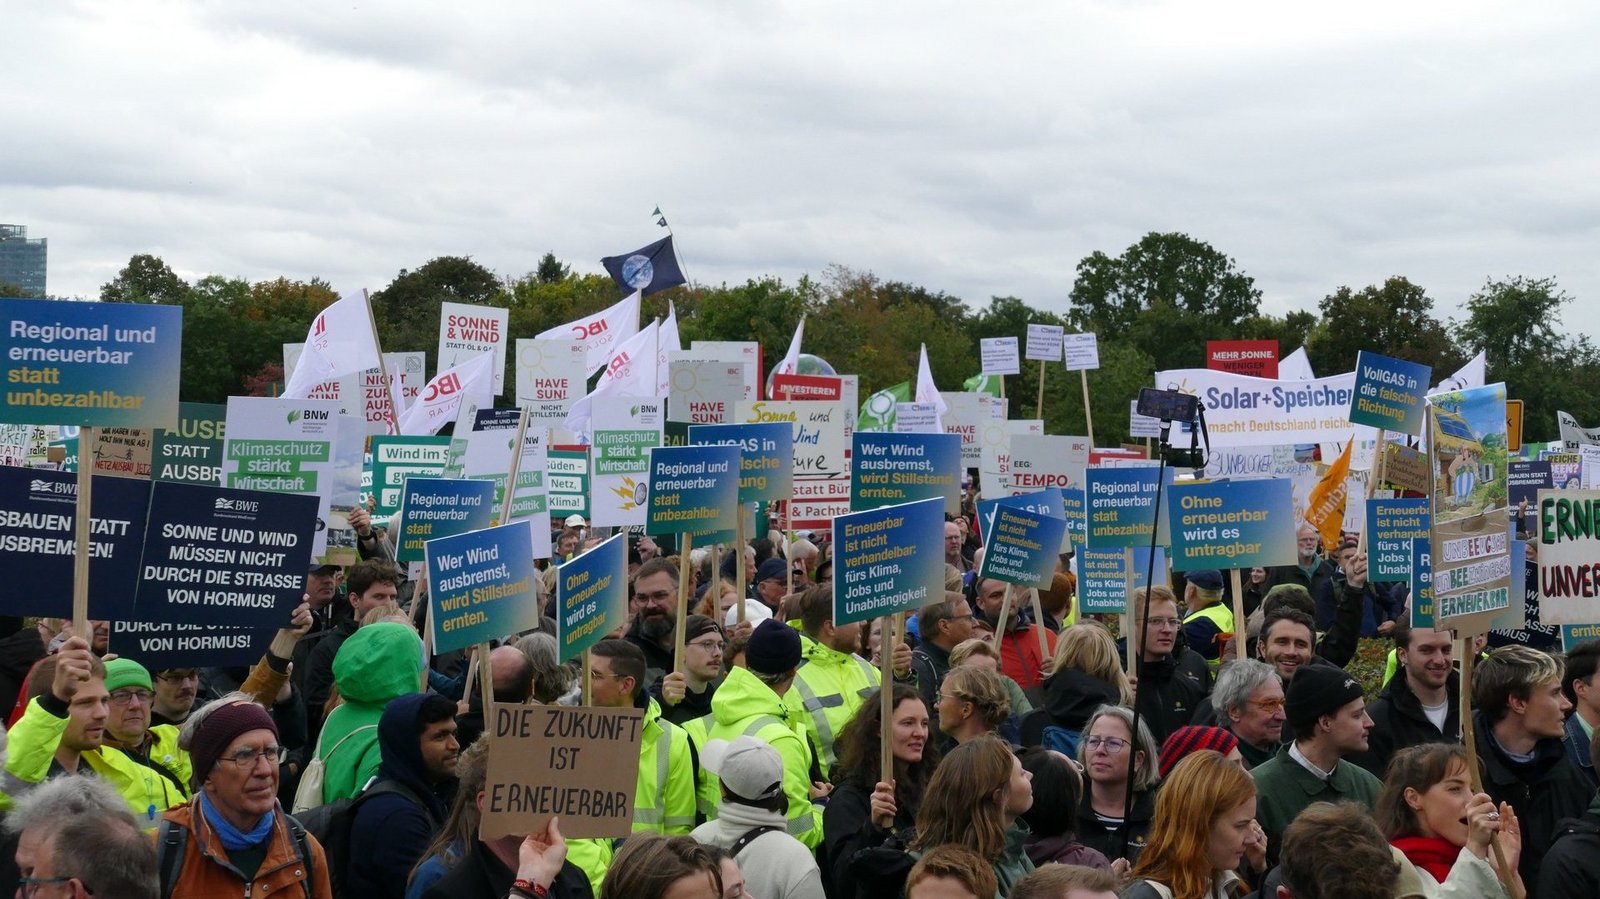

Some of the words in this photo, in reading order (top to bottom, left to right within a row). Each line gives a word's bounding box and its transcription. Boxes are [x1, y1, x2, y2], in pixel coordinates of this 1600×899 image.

[448, 315, 499, 331] SONNE
[10, 320, 108, 344] Regional
[115, 326, 156, 343] und
[447, 328, 456, 339] &
[461, 329, 500, 343] WIND
[446, 342, 466, 350] STATT
[9, 345, 133, 365] erneuerbar
[8, 367, 59, 384] statt
[1363, 366, 1405, 385] VollGAS
[1407, 374, 1417, 389] in
[535, 379, 568, 388] HAVE
[780, 385, 836, 396] INVESTIEREN
[6, 390, 145, 410] unbezahlbar
[537, 390, 567, 400] SUN!
[1360, 383, 1377, 397] die
[1379, 387, 1417, 406] falsche
[303, 409, 329, 420] BNW
[641, 405, 657, 413] BNW
[690, 403, 724, 411] HAVE
[1357, 400, 1405, 421] Richtung
[692, 414, 724, 423] SUN!
[810, 408, 832, 422] und
[947, 425, 975, 433] HAVE
[1208, 419, 1246, 433] macht
[1249, 418, 1316, 431] Deutschland
[596, 433, 655, 444] Klimaschutz
[763, 438, 776, 451] in
[162, 444, 210, 459] STATT
[232, 442, 323, 457] Klimaschutz
[386, 448, 419, 459] Wind
[423, 448, 440, 459] im
[607, 445, 636, 457] stärkt
[861, 444, 888, 456] Wer
[891, 443, 924, 456] Wind
[247, 458, 292, 473] stärkt
[600, 459, 646, 471] Wirtschaft
[657, 462, 705, 476] Regional
[708, 461, 728, 472] und
[860, 458, 934, 472] ausbremst,
[233, 476, 305, 491] Wirtschaft
[551, 479, 577, 490] Netz,
[655, 477, 716, 490] erneuerbar
[860, 473, 889, 485] wird
[891, 472, 954, 485] Stillstand
[1013, 474, 1068, 486] TEMPO
[793, 484, 823, 495] statt
[860, 487, 906, 499] ernten.
[1092, 482, 1140, 495] Regional
[235, 500, 259, 512] BWE
[410, 493, 459, 508] Regional
[461, 494, 481, 506] und
[549, 496, 580, 507] Klima!
[655, 494, 680, 505] statt
[1092, 496, 1152, 507] erneuerbar
[1181, 496, 1222, 510] Ohne
[408, 509, 469, 520] erneuerbar
[653, 508, 720, 521] unbezahlbar
[1001, 511, 1040, 527] Erneuerbar
[1092, 511, 1118, 521] statt
[1182, 509, 1268, 524] erneuerbar
[89, 518, 131, 536] TATT
[406, 524, 432, 535] statt
[845, 515, 904, 537] Erneuerbar
[999, 523, 1009, 534] ist
[1010, 525, 1027, 536] nicht
[1377, 518, 1390, 527] ist
[1393, 518, 1420, 527] nicht
[162, 523, 218, 543] SONNE
[221, 528, 255, 544] UND
[258, 530, 298, 548] WIND
[1183, 528, 1217, 541] wird
[1221, 530, 1240, 539] es
[845, 540, 859, 552] ist
[861, 535, 887, 549] nicht
[996, 534, 1042, 551] verhandelbar:
[1185, 542, 1262, 558] untragbar
[1378, 541, 1399, 550] fürs
[169, 544, 236, 564] MÜSSEN
[239, 550, 285, 568] NICHT
[437, 555, 462, 572] Wer
[466, 545, 499, 564] Wind
[845, 545, 916, 568] verhandelbar:
[993, 543, 1007, 554] fürs
[1008, 545, 1030, 560] Klima,
[1378, 553, 1405, 562] Jobs
[991, 553, 1006, 565] Jobs
[1007, 557, 1023, 567] und
[1085, 561, 1094, 569] ist
[1097, 560, 1118, 569] nicht
[144, 566, 201, 584] DURCH
[205, 570, 231, 586] DIE
[234, 571, 302, 590] STRASSE
[440, 563, 510, 592] ausbremst,
[567, 570, 589, 591] Ohne
[845, 568, 866, 583] fürs
[869, 563, 902, 580] Klima,
[988, 564, 1041, 582] Unabhängigkeit
[567, 574, 611, 609] erneuerbar
[845, 585, 872, 599] Jobs
[874, 578, 894, 593] und
[1085, 580, 1103, 588] fürs
[167, 589, 200, 606] VON
[203, 591, 276, 609] HORMUS!
[441, 594, 469, 612] wird
[472, 577, 529, 604] Stillstand
[845, 586, 927, 615] Unabhängigkeit
[1086, 590, 1107, 598] Jobs
[1109, 590, 1125, 598] und
[1441, 588, 1507, 617] ERNEUERBAR
[567, 606, 585, 626] wird
[587, 601, 596, 615] es
[442, 611, 488, 632] ernten.
[567, 611, 606, 644] untragbar
[140, 638, 174, 651] VON
[178, 635, 251, 650] HORMUS!
[497, 708, 533, 738] DIE
[544, 710, 641, 742] ZUKUNFT
[550, 747, 580, 770] IST
[490, 783, 627, 818] ERNEUERBAR
